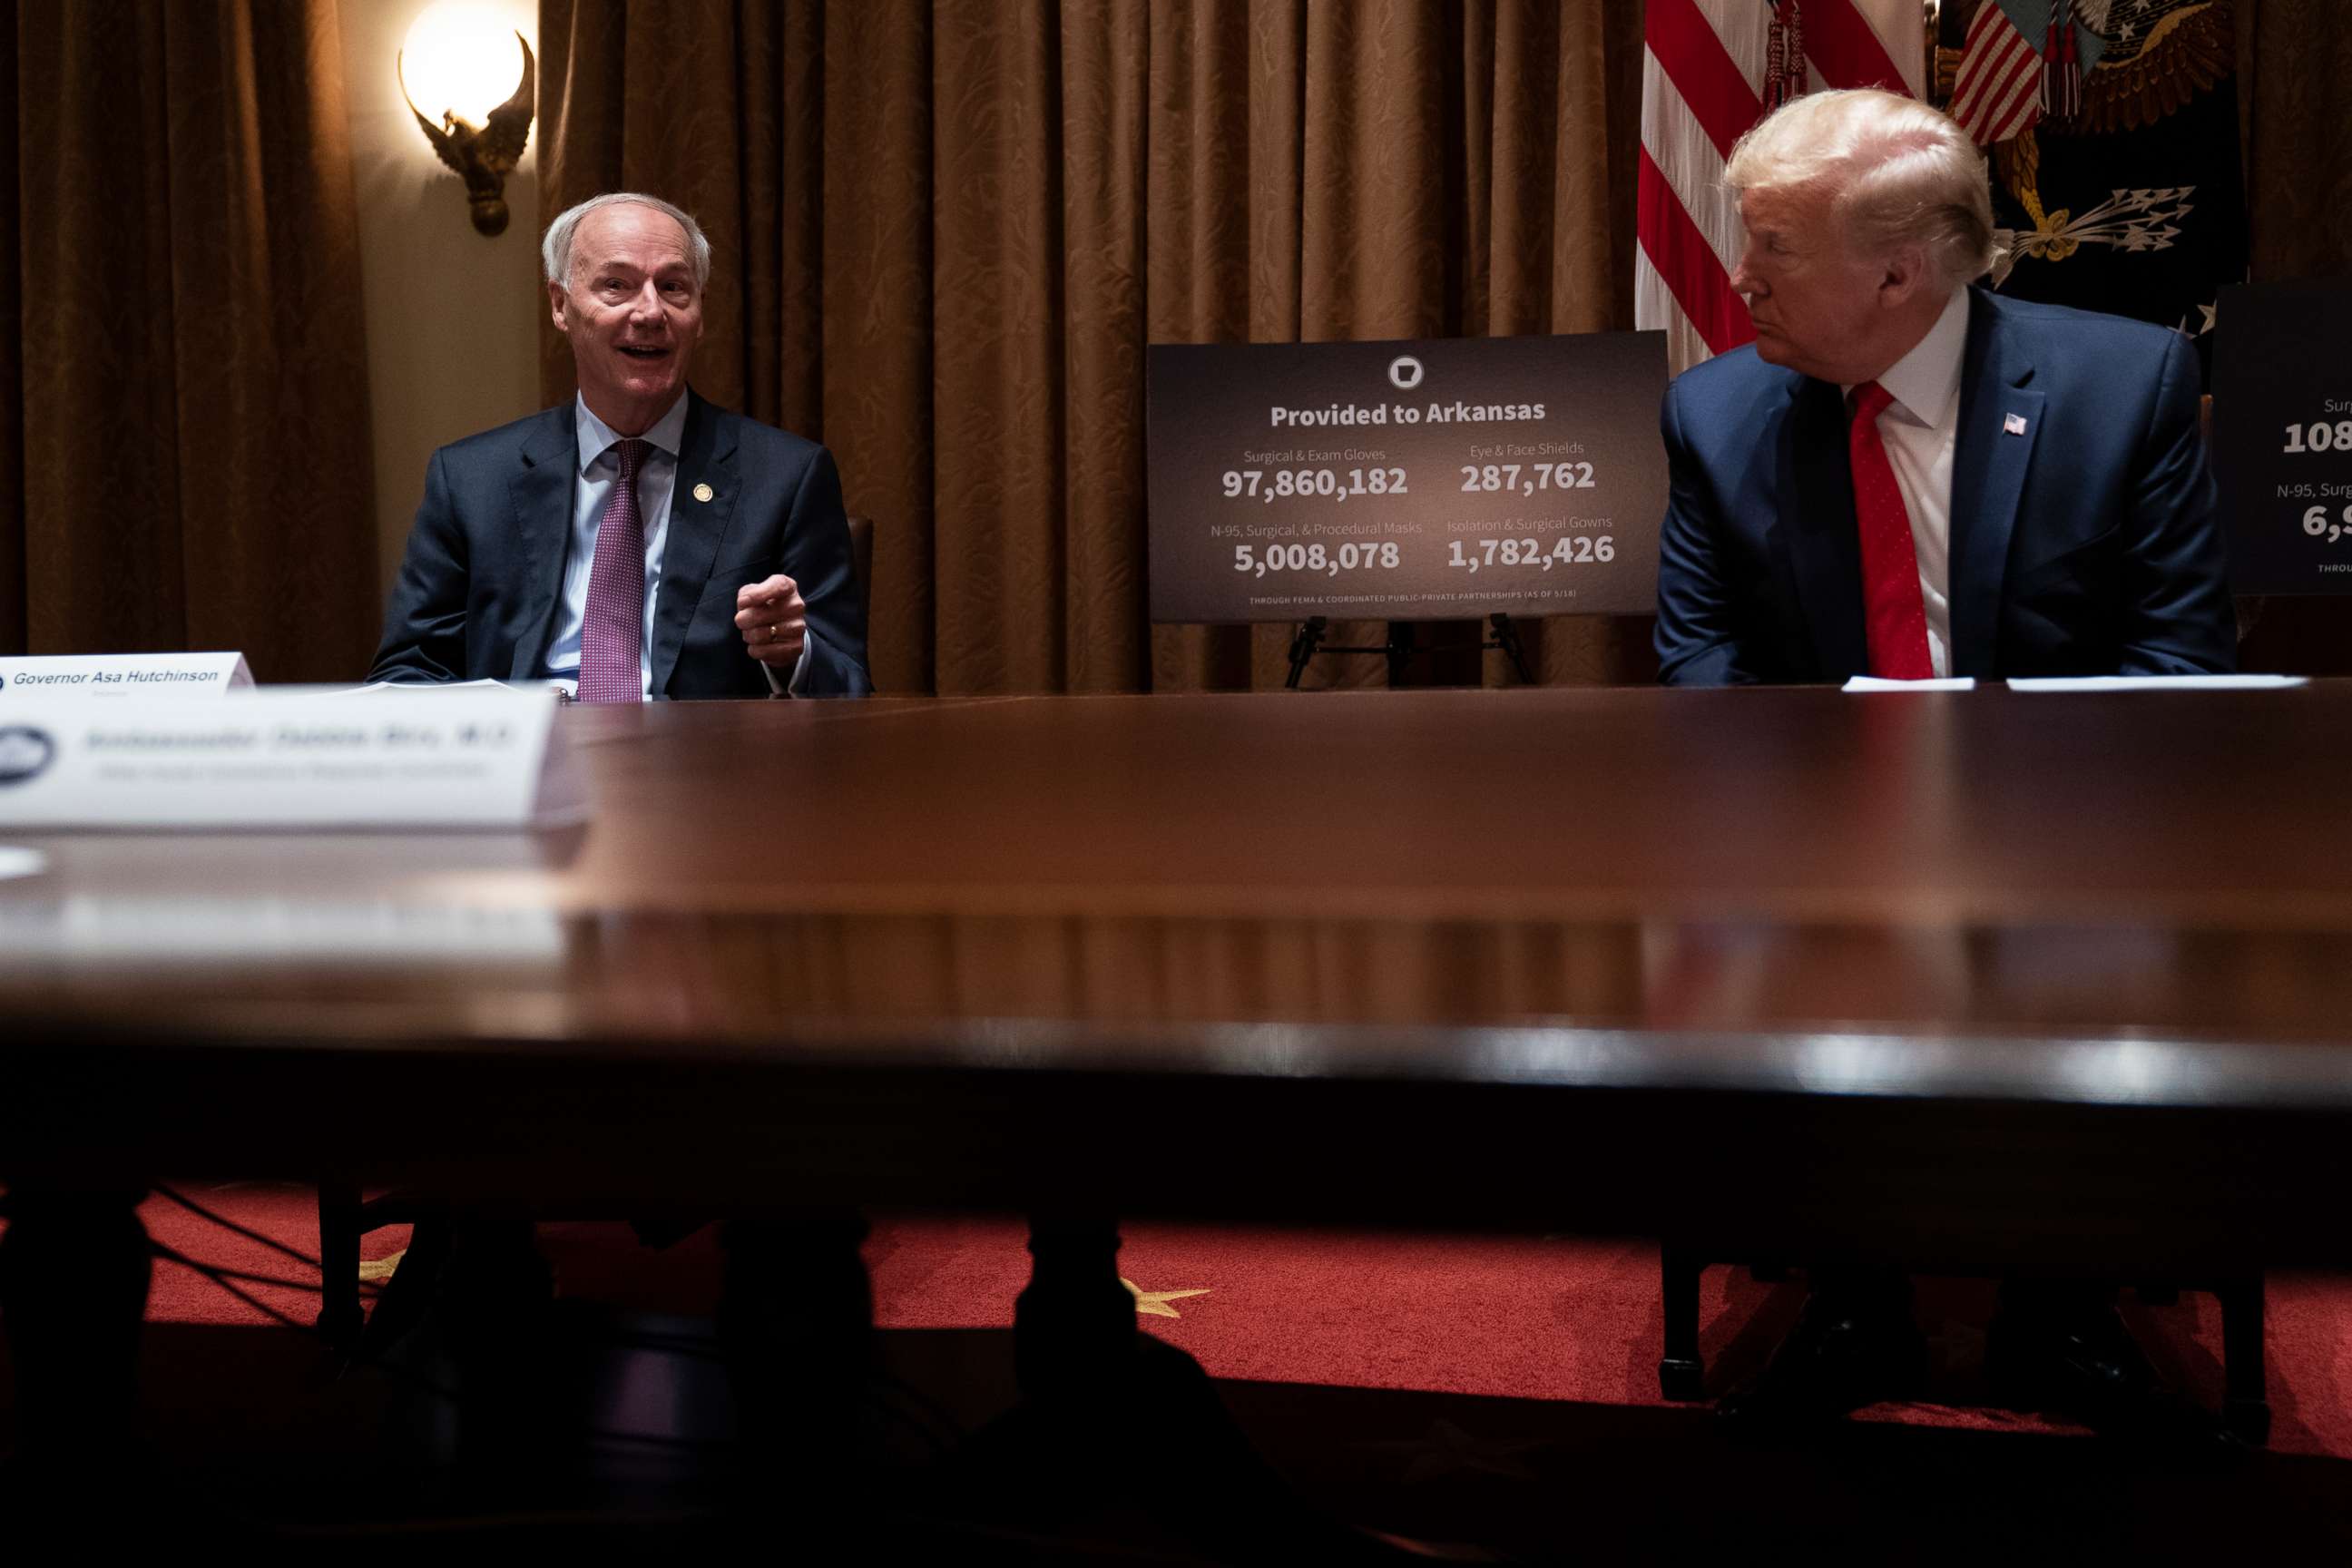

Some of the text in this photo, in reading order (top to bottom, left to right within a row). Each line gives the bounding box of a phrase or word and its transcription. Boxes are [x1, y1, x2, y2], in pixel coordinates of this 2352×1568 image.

[1271, 401, 1545, 426] Provided to Arkansas
[2283, 420, 2352, 452] 108
[1244, 448, 1386, 465] Surgical & Exam Gloves
[1470, 442, 1584, 460] Eye & Face Shields
[1222, 467, 1408, 504] 97,860,182
[1461, 462, 1595, 497] 287,762
[2277, 483, 2316, 499] N-95,
[1210, 522, 1423, 539] N-95, Surgical, & Procedural Masks
[1447, 515, 1612, 533] Isolation & Surgical Gowns
[1234, 542, 1400, 578] 5,008,078
[1448, 535, 1615, 573] 1,782,426
[1250, 596, 1290, 605] THROUGH
[1293, 596, 1317, 604] FEMA
[1326, 594, 1386, 603] COORDINATED
[1387, 593, 1455, 603] PUBLIC-PRIVATE
[1458, 592, 1522, 602] PARTNERSHIPS
[1524, 591, 1539, 601] (AS
[1541, 590, 1552, 599] OF
[14, 670, 219, 685] Governor Asa Hutchinson
